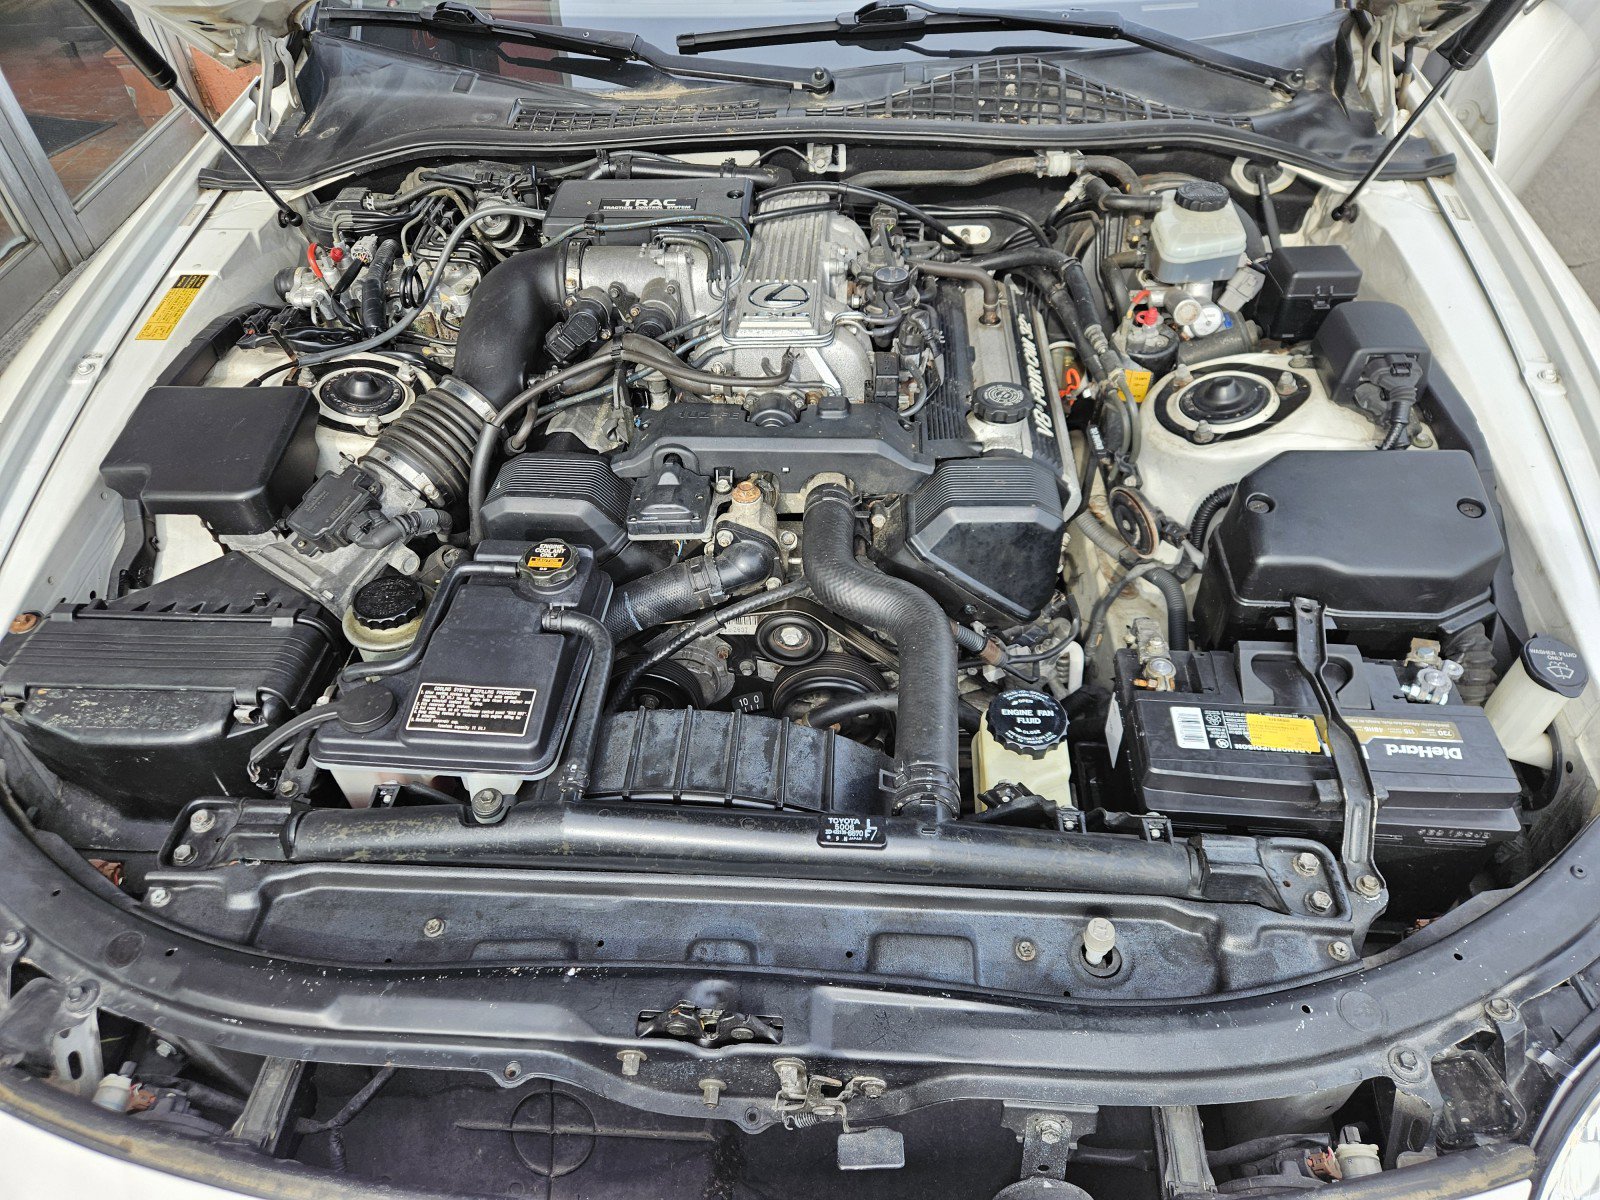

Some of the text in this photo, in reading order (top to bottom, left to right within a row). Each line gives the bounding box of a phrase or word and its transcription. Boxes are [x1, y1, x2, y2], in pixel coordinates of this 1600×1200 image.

[1020, 337, 1040, 368] CAM
[1028, 368, 1048, 406] FOUR
[1032, 410, 1054, 438] V8
[739, 695, 759, 707] 10 0
[1386, 744, 1463, 760] DieHard
